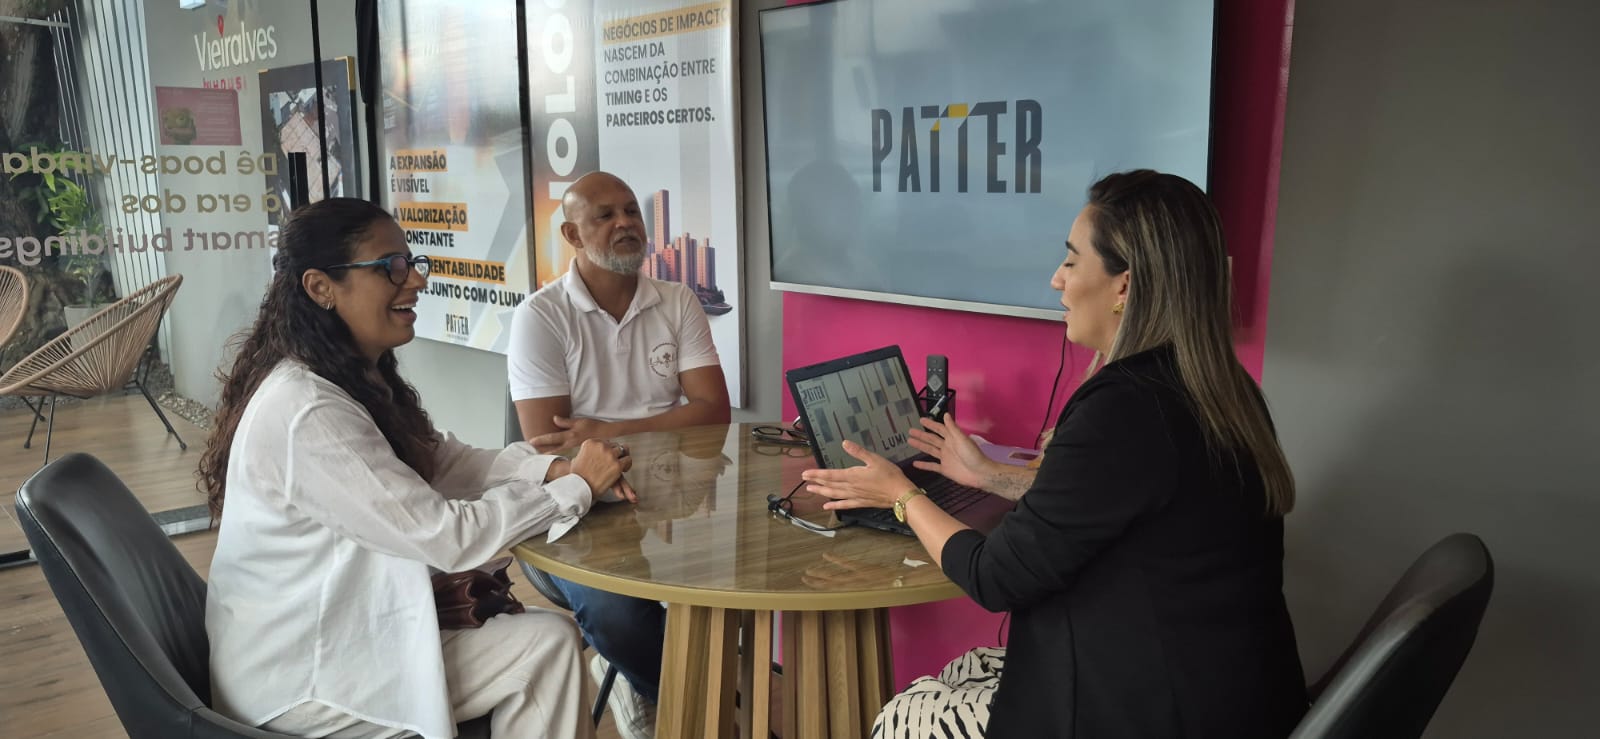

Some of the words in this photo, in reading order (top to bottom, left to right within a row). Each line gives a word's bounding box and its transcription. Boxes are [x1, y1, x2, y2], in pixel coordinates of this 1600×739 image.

[603, 19, 657, 41] NEGÓCIOS
[660, 17, 674, 33] DE
[194, 21, 277, 71] Vieiralves
[604, 44, 647, 63] NASCEM
[650, 41, 665, 57] DA
[605, 61, 678, 84] COMBINAÇÃO
[681, 58, 716, 77] ENTRE
[606, 89, 642, 106] TIMING
[645, 89, 650, 103] E
[653, 87, 668, 102] OS
[606, 110, 665, 127] PARCEIROS
[667, 106, 715, 124] CERTOS.
[871, 99, 1043, 194] PATTER
[390, 156, 397, 170] A
[397, 150, 446, 170] EXPANSÃO
[391, 173, 396, 192] É
[397, 173, 430, 193] VISÍVEL
[400, 204, 467, 229] VALORIZAÇÃO
[405, 230, 454, 248] ONSTANTE
[430, 281, 461, 299] JUNTO
[463, 286, 488, 303] COM
[489, 290, 498, 305] O
[446, 314, 469, 335] PATTER
